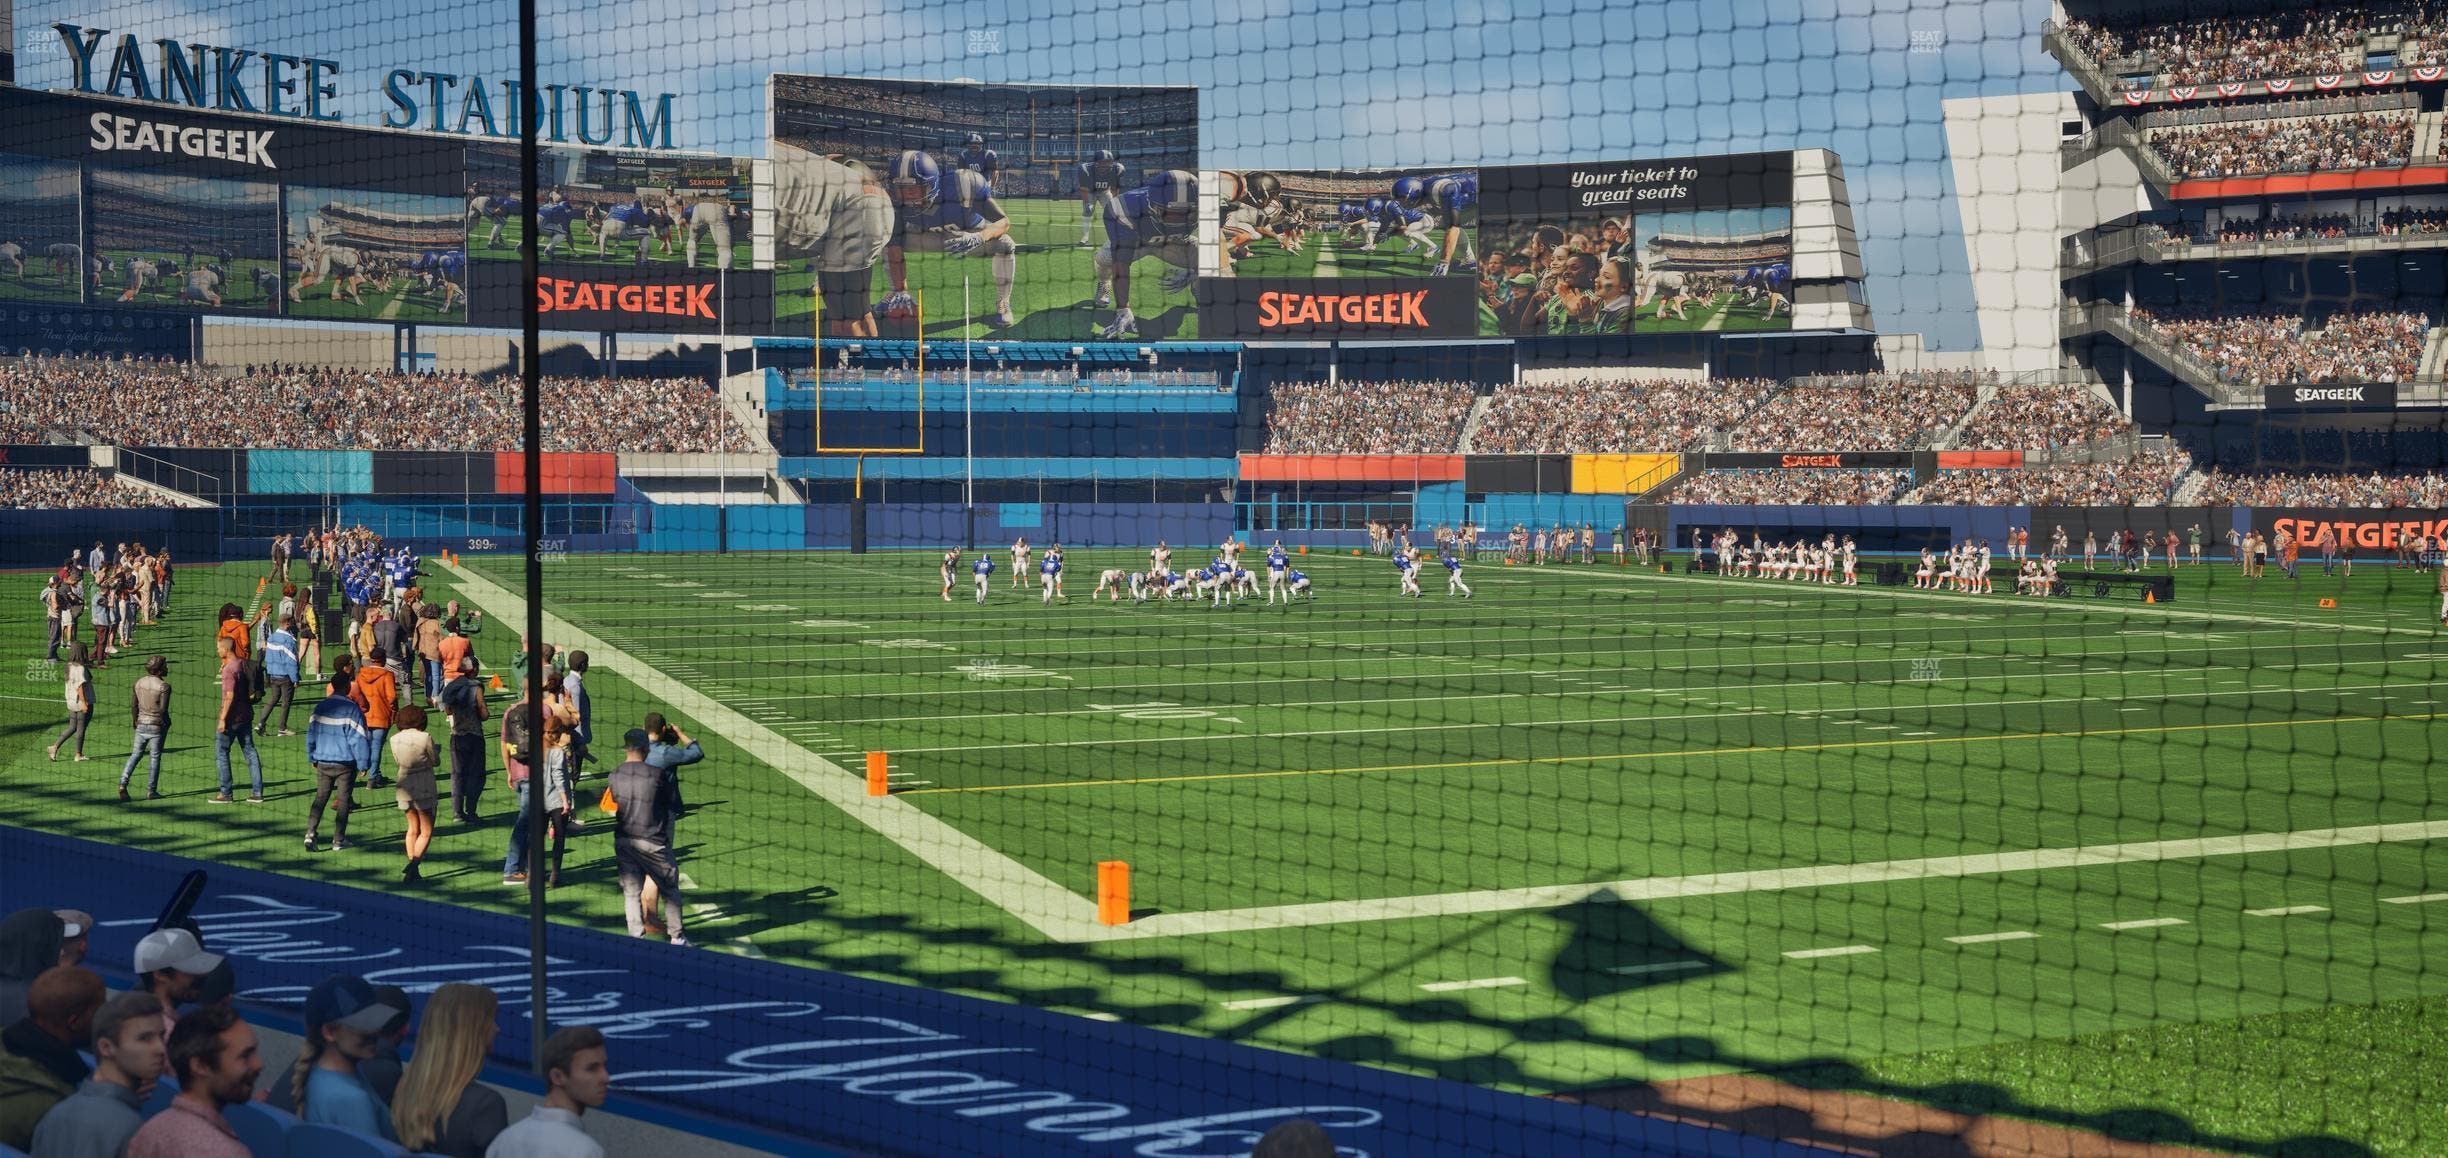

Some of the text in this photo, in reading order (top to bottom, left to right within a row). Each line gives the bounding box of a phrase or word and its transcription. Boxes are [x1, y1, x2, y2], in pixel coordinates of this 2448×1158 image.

[51, 23, 677, 150] YANKEE STADIUM
[90, 112, 278, 169] SEATGEEK
[1572, 165, 1699, 188] Your ticket to
[1582, 184, 1687, 207] great seats
[536, 276, 717, 320] SEATGEEK
[1258, 289, 1430, 328] SEATGEEK
[2294, 386, 2365, 402] SEATGEEK
